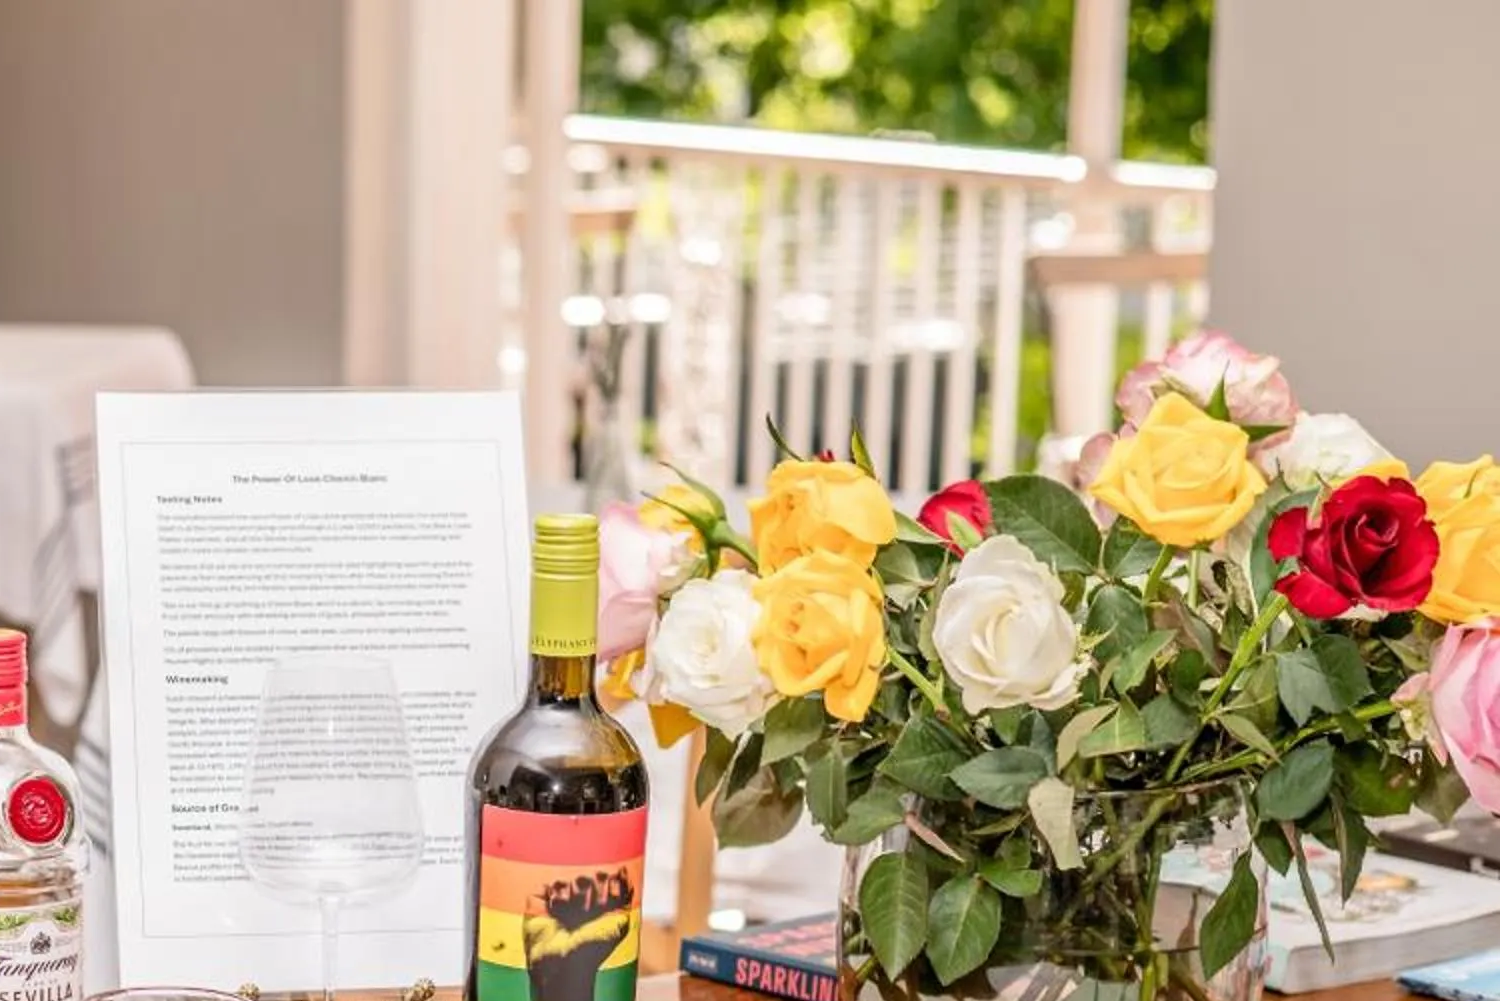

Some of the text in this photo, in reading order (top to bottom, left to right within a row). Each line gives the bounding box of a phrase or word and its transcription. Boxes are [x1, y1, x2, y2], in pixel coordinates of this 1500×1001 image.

[164, 674, 229, 686] Winemaking
[171, 803, 207, 814] Source
[209, 803, 220, 814] of
